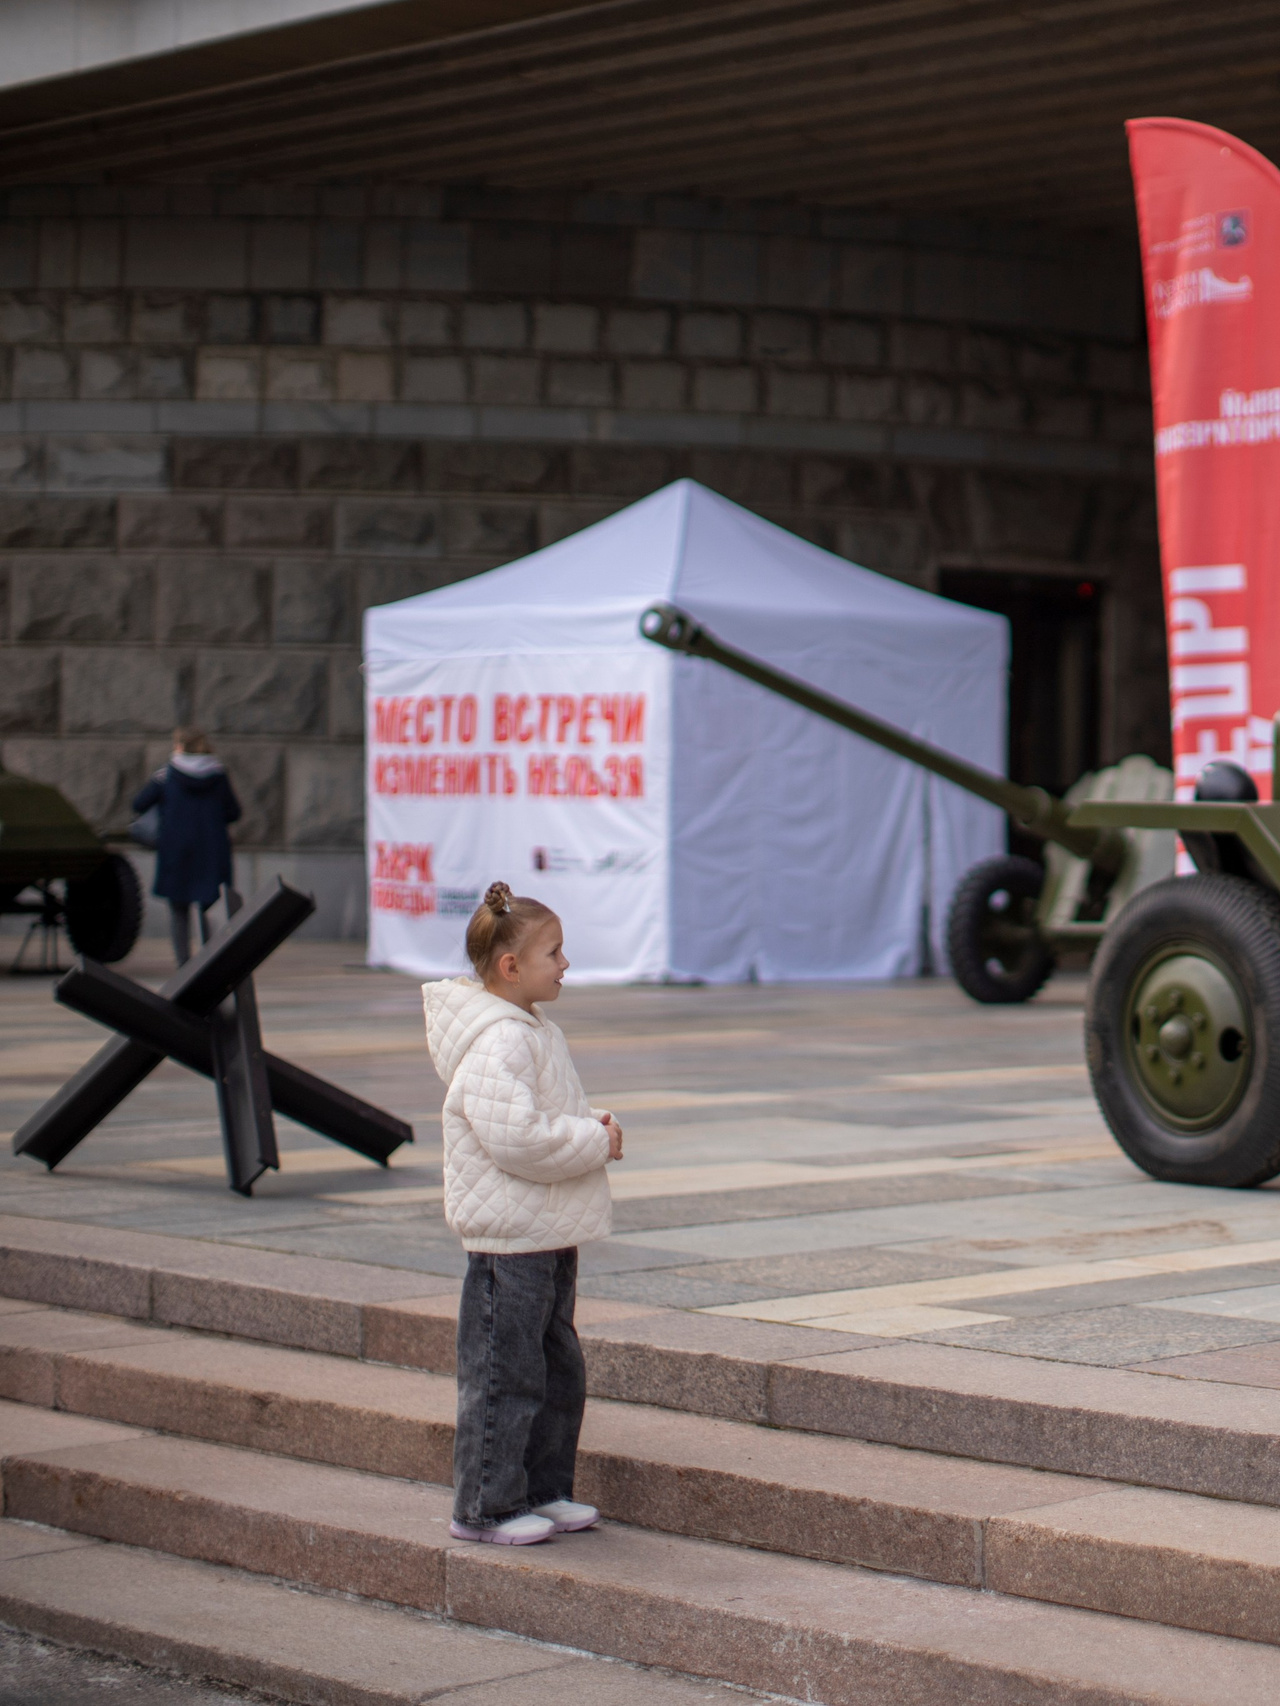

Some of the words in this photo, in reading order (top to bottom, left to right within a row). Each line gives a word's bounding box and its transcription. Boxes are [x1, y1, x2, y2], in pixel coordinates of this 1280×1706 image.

[375, 694, 478, 743] МЕСТО
[493, 692, 646, 744] ВСТРЕЧИ
[374, 753, 518, 796] ИЗМЕНИТЬ
[527, 753, 644, 797] НЕЛЬЗЯ
